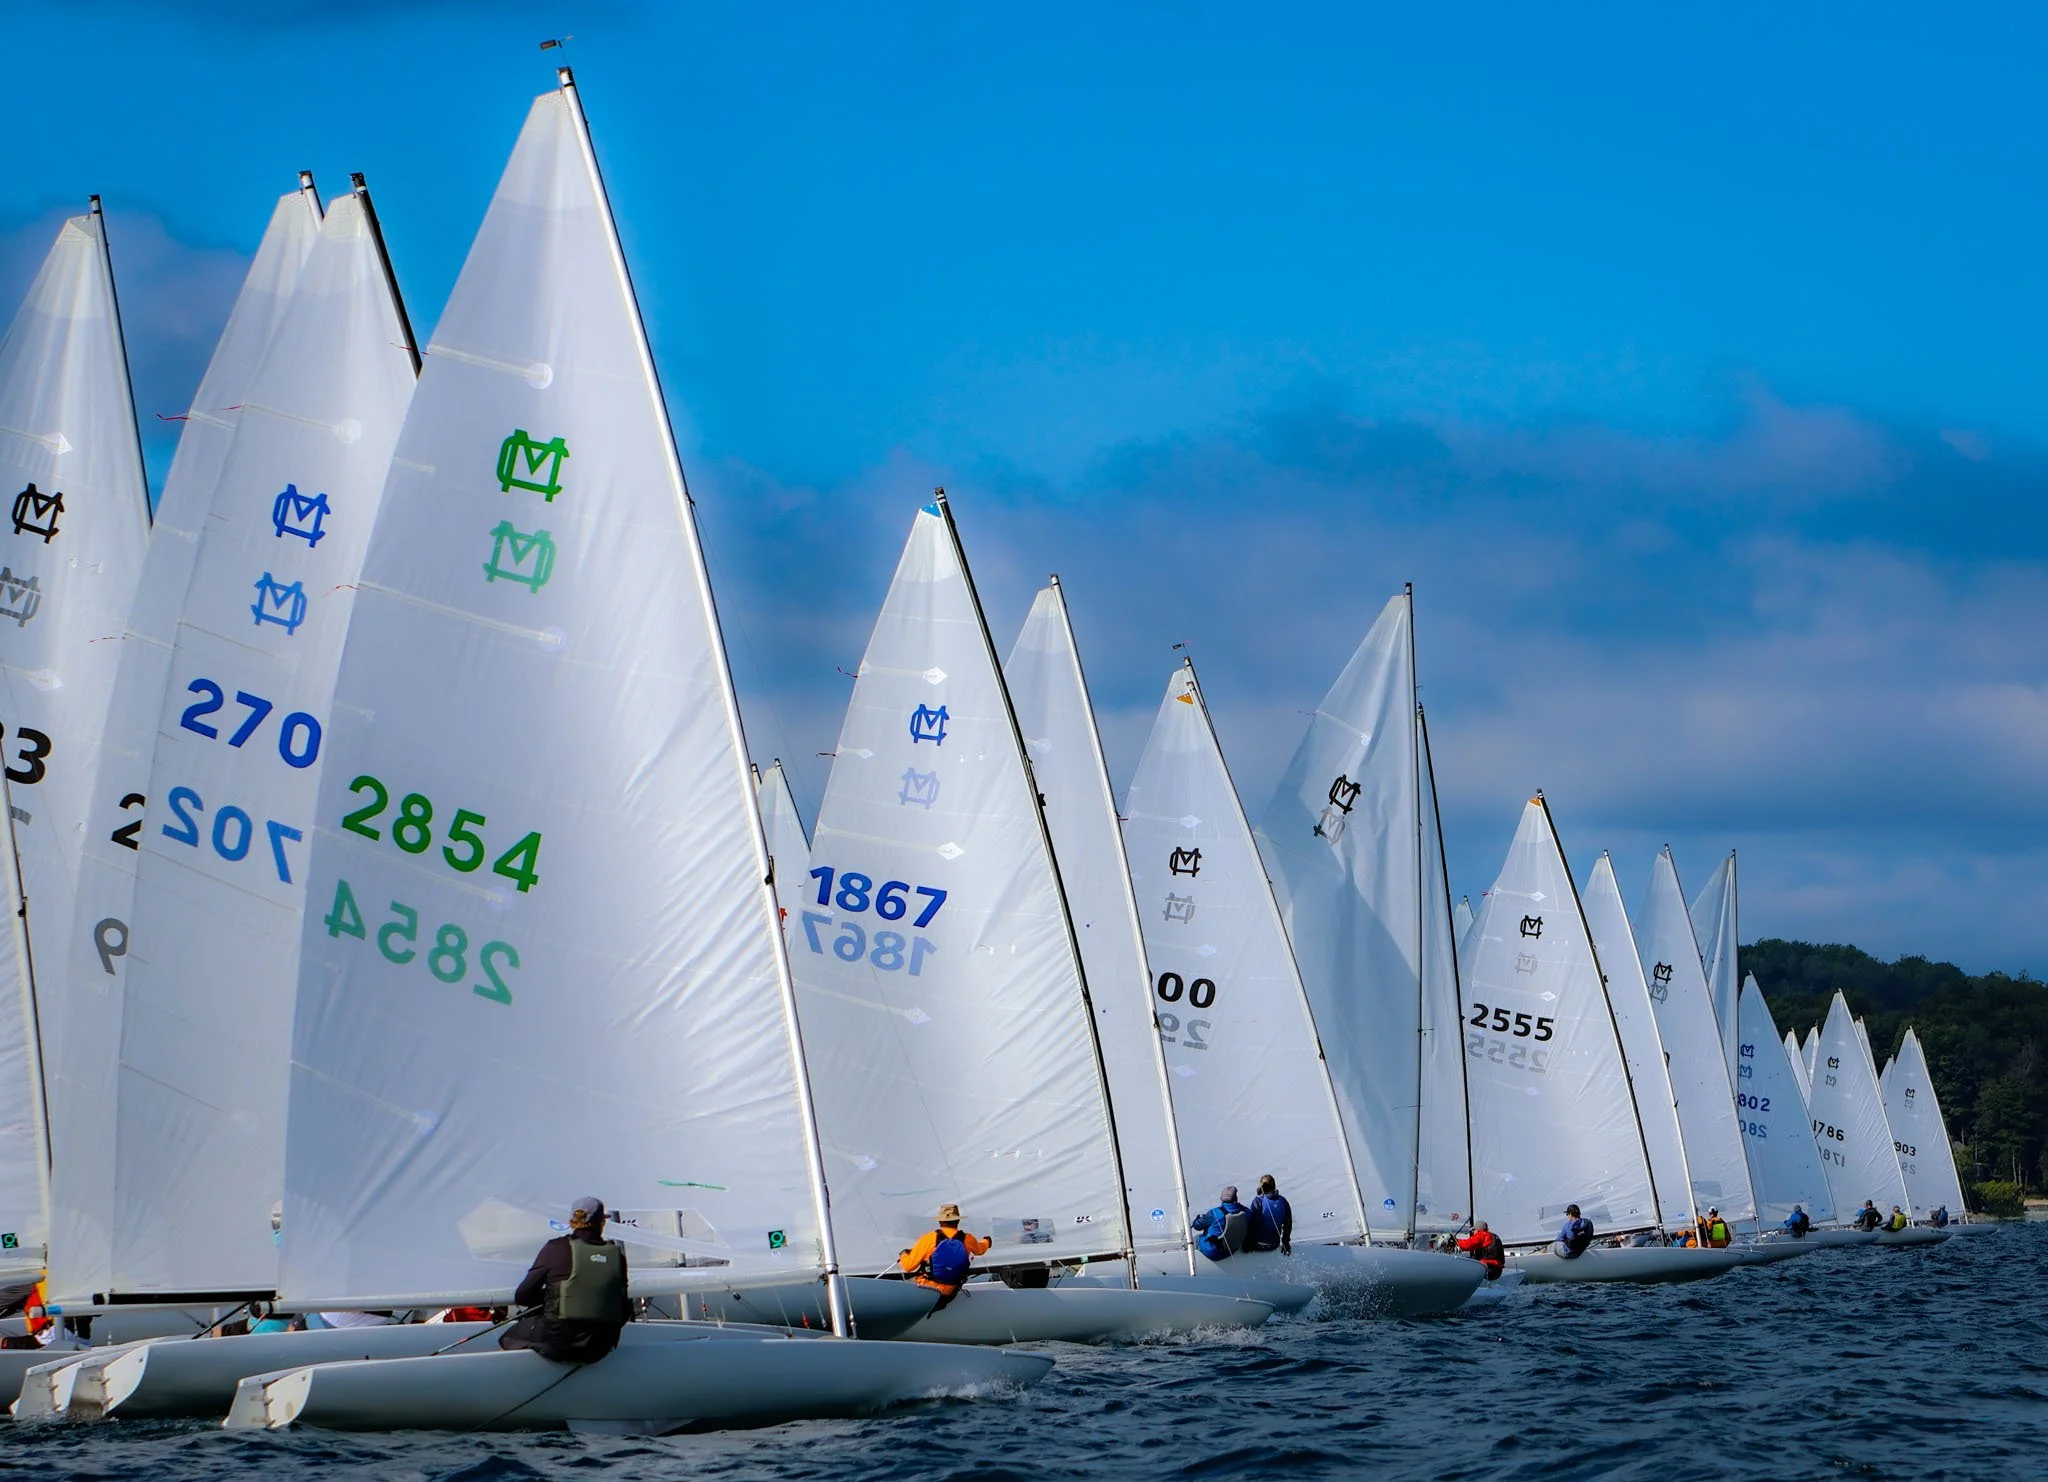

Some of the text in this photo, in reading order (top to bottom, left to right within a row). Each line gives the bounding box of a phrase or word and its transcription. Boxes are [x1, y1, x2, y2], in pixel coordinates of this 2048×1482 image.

[180, 678, 322, 768] 270
[0, 720, 51, 784] 3
[341, 775, 542, 893] 2854
[809, 866, 948, 928] 1867
[1151, 971, 1216, 1009] 00
[1470, 1003, 1554, 1042] 2555
[1738, 1093, 1770, 1112] 802
[1813, 1119, 1844, 1141] 1786
[1895, 1141, 1916, 1157] 903
